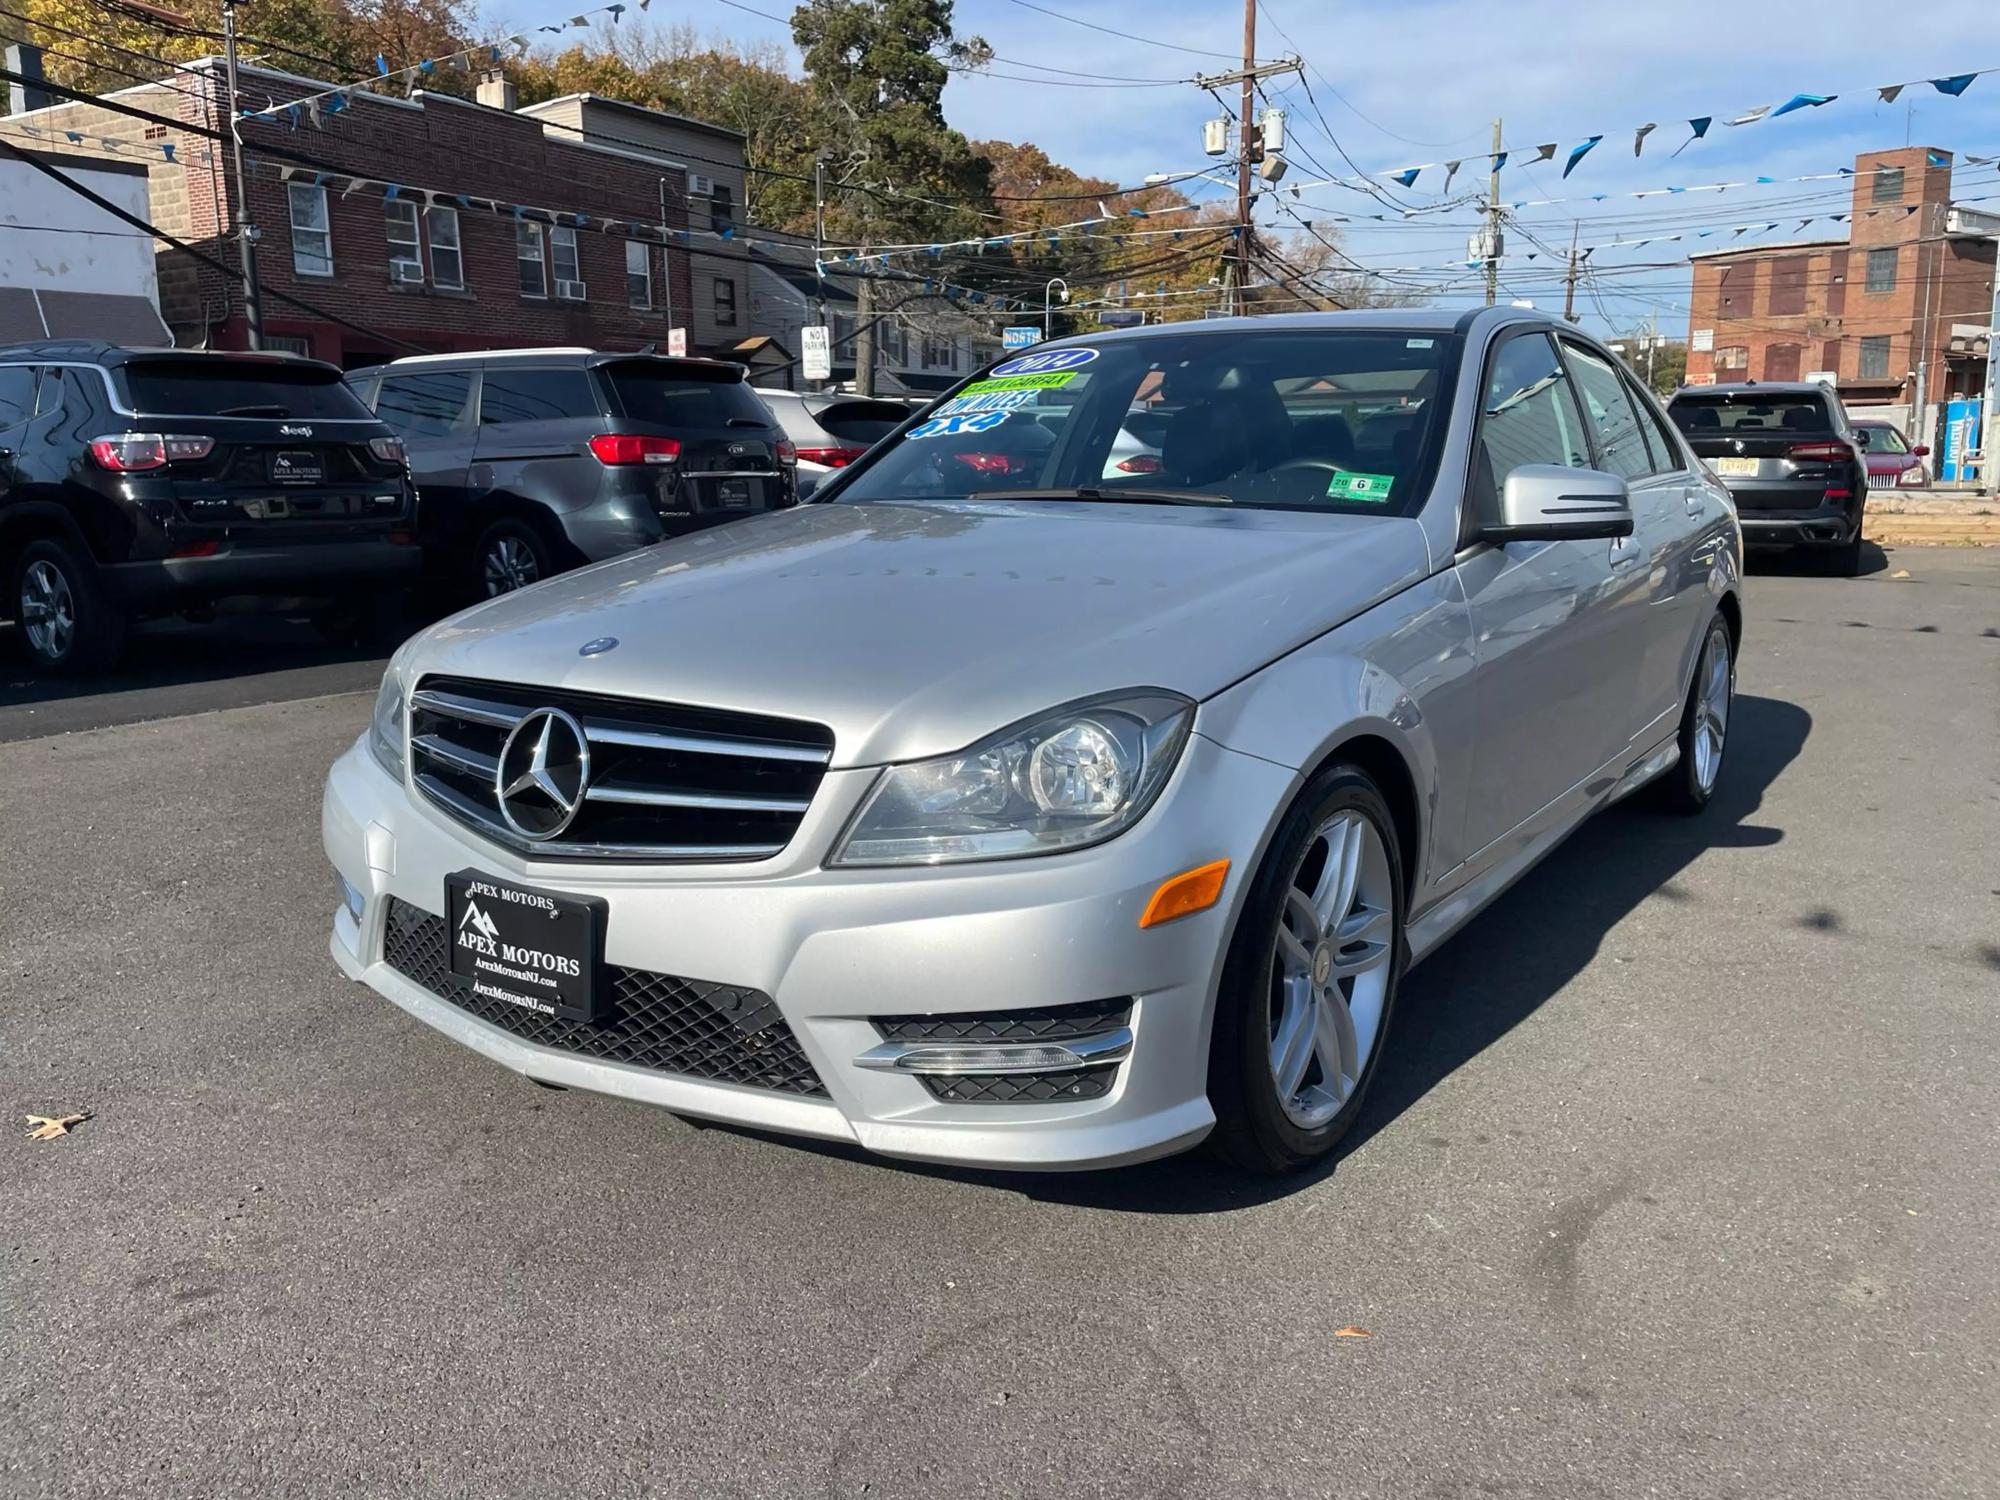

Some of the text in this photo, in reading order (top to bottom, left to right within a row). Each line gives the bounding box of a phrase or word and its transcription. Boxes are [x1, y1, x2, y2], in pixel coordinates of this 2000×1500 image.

[1004, 332, 1042, 344] NORTH
[1000, 352, 1088, 375] 2014
[279, 425, 313, 438] Jeep
[906, 411, 1010, 440] 4X4
[1357, 480, 1366, 489] 6
[470, 881, 555, 910] APEX MOTORS
[457, 930, 580, 976] APEX MOTORS
